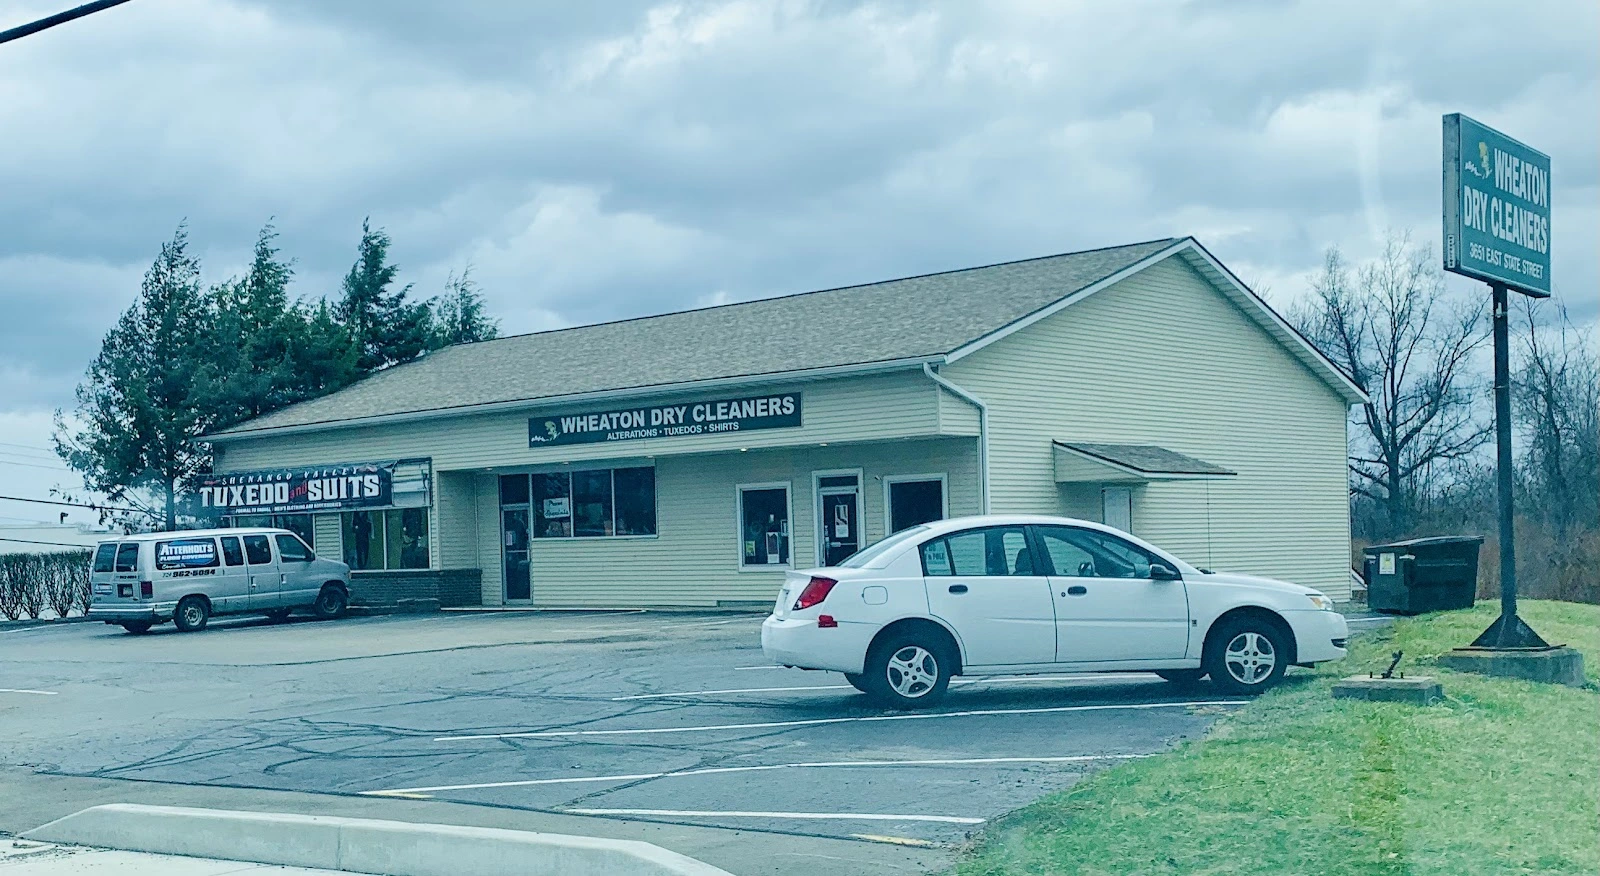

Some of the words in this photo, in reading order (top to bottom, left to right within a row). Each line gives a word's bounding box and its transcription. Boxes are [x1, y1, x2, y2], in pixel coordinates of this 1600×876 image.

[1494, 148, 1547, 208] WHEATON
[1464, 185, 1488, 232] DRY
[1491, 197, 1547, 255] CLEANERS
[1469, 242, 1485, 260] 3651
[1486, 246, 1502, 267] EAST
[1504, 253, 1521, 273] STATE
[1522, 260, 1543, 279] STREET
[561, 409, 645, 434] WHEATON
[651, 406, 687, 426] DRY
[692, 397, 795, 422] CLEANERS
[607, 429, 658, 441] ALTERATIONS
[664, 425, 702, 436] TUXEDOS
[709, 422, 739, 432] SHIRTS
[200, 482, 290, 508] TUXEDO
[308, 474, 381, 501] SUITS
[222, 472, 293, 486] SHENANGO
[304, 466, 359, 479] VALLEY
